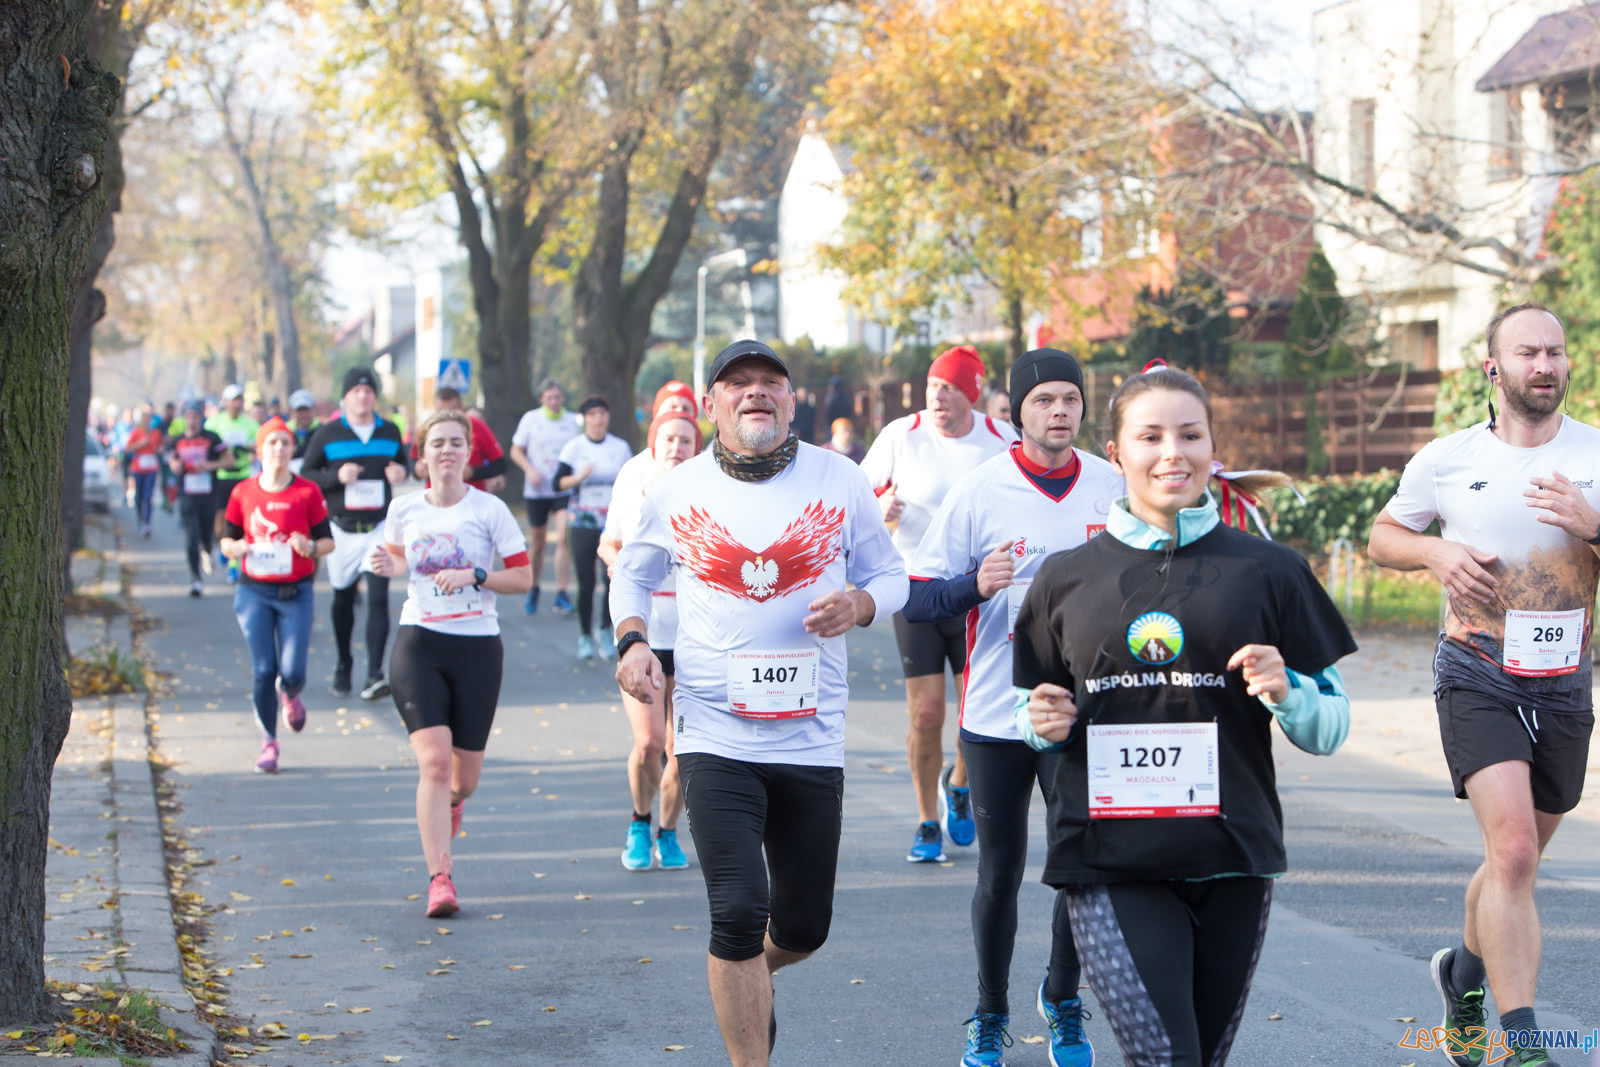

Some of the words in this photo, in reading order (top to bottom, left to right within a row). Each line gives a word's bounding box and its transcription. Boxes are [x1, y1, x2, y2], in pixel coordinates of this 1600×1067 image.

[1469, 482, 1488, 490] 4F
[1533, 627, 1564, 642] 269
[752, 667, 798, 683] 1407
[1085, 670, 1168, 694] WSPÓLNA
[1171, 672, 1226, 688] DROGA
[1120, 747, 1182, 768] 1207
